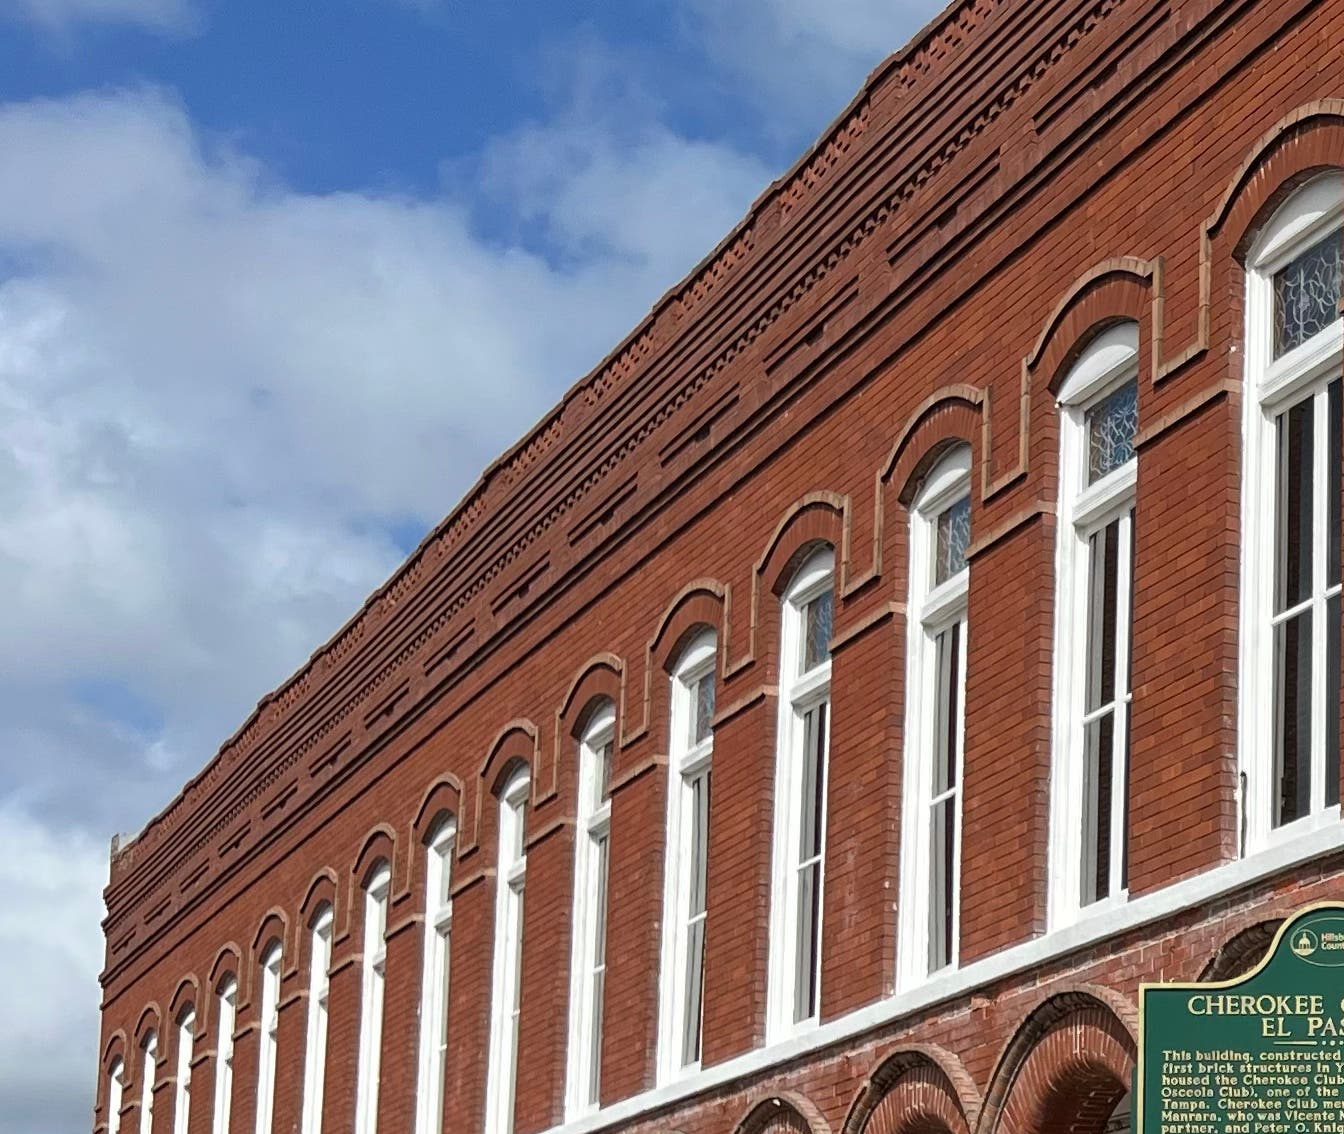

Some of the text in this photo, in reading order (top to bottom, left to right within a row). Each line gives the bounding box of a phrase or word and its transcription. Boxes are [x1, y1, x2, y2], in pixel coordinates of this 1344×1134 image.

[1187, 994, 1325, 1015] CHEROKEE
[1261, 1017, 1292, 1037] EL
[1162, 1050, 1192, 1061] This
[1195, 1050, 1254, 1062] building,
[1259, 1050, 1342, 1060] constructed
[1162, 1064, 1193, 1074] first
[1198, 1063, 1234, 1073] brick
[1239, 1063, 1312, 1073] structures
[1316, 1063, 1330, 1073] in
[1161, 1075, 1210, 1085] housed
[1214, 1075, 1238, 1085] the
[1242, 1075, 1308, 1085] Cherokee
[1313, 1075, 1344, 1085] Club
[1160, 1087, 1214, 1097] Osceola
[1218, 1087, 1258, 1098] Club),
[1266, 1089, 1291, 1097] one
[1295, 1087, 1310, 1097] of
[1315, 1087, 1339, 1097] the
[1163, 1099, 1210, 1111] Tampa.
[1217, 1099, 1282, 1109] Cherokee
[1286, 1099, 1318, 1109] Club
[1161, 1111, 1222, 1122] Manrara,
[1226, 1111, 1254, 1121] who
[1256, 1113, 1281, 1121] was
[1285, 1111, 1336, 1121] Vicente
[1161, 1123, 1219, 1134] partner,
[1224, 1123, 1250, 1133] and
[1254, 1123, 1291, 1133] Peter
[1295, 1123, 1310, 1133] O.
